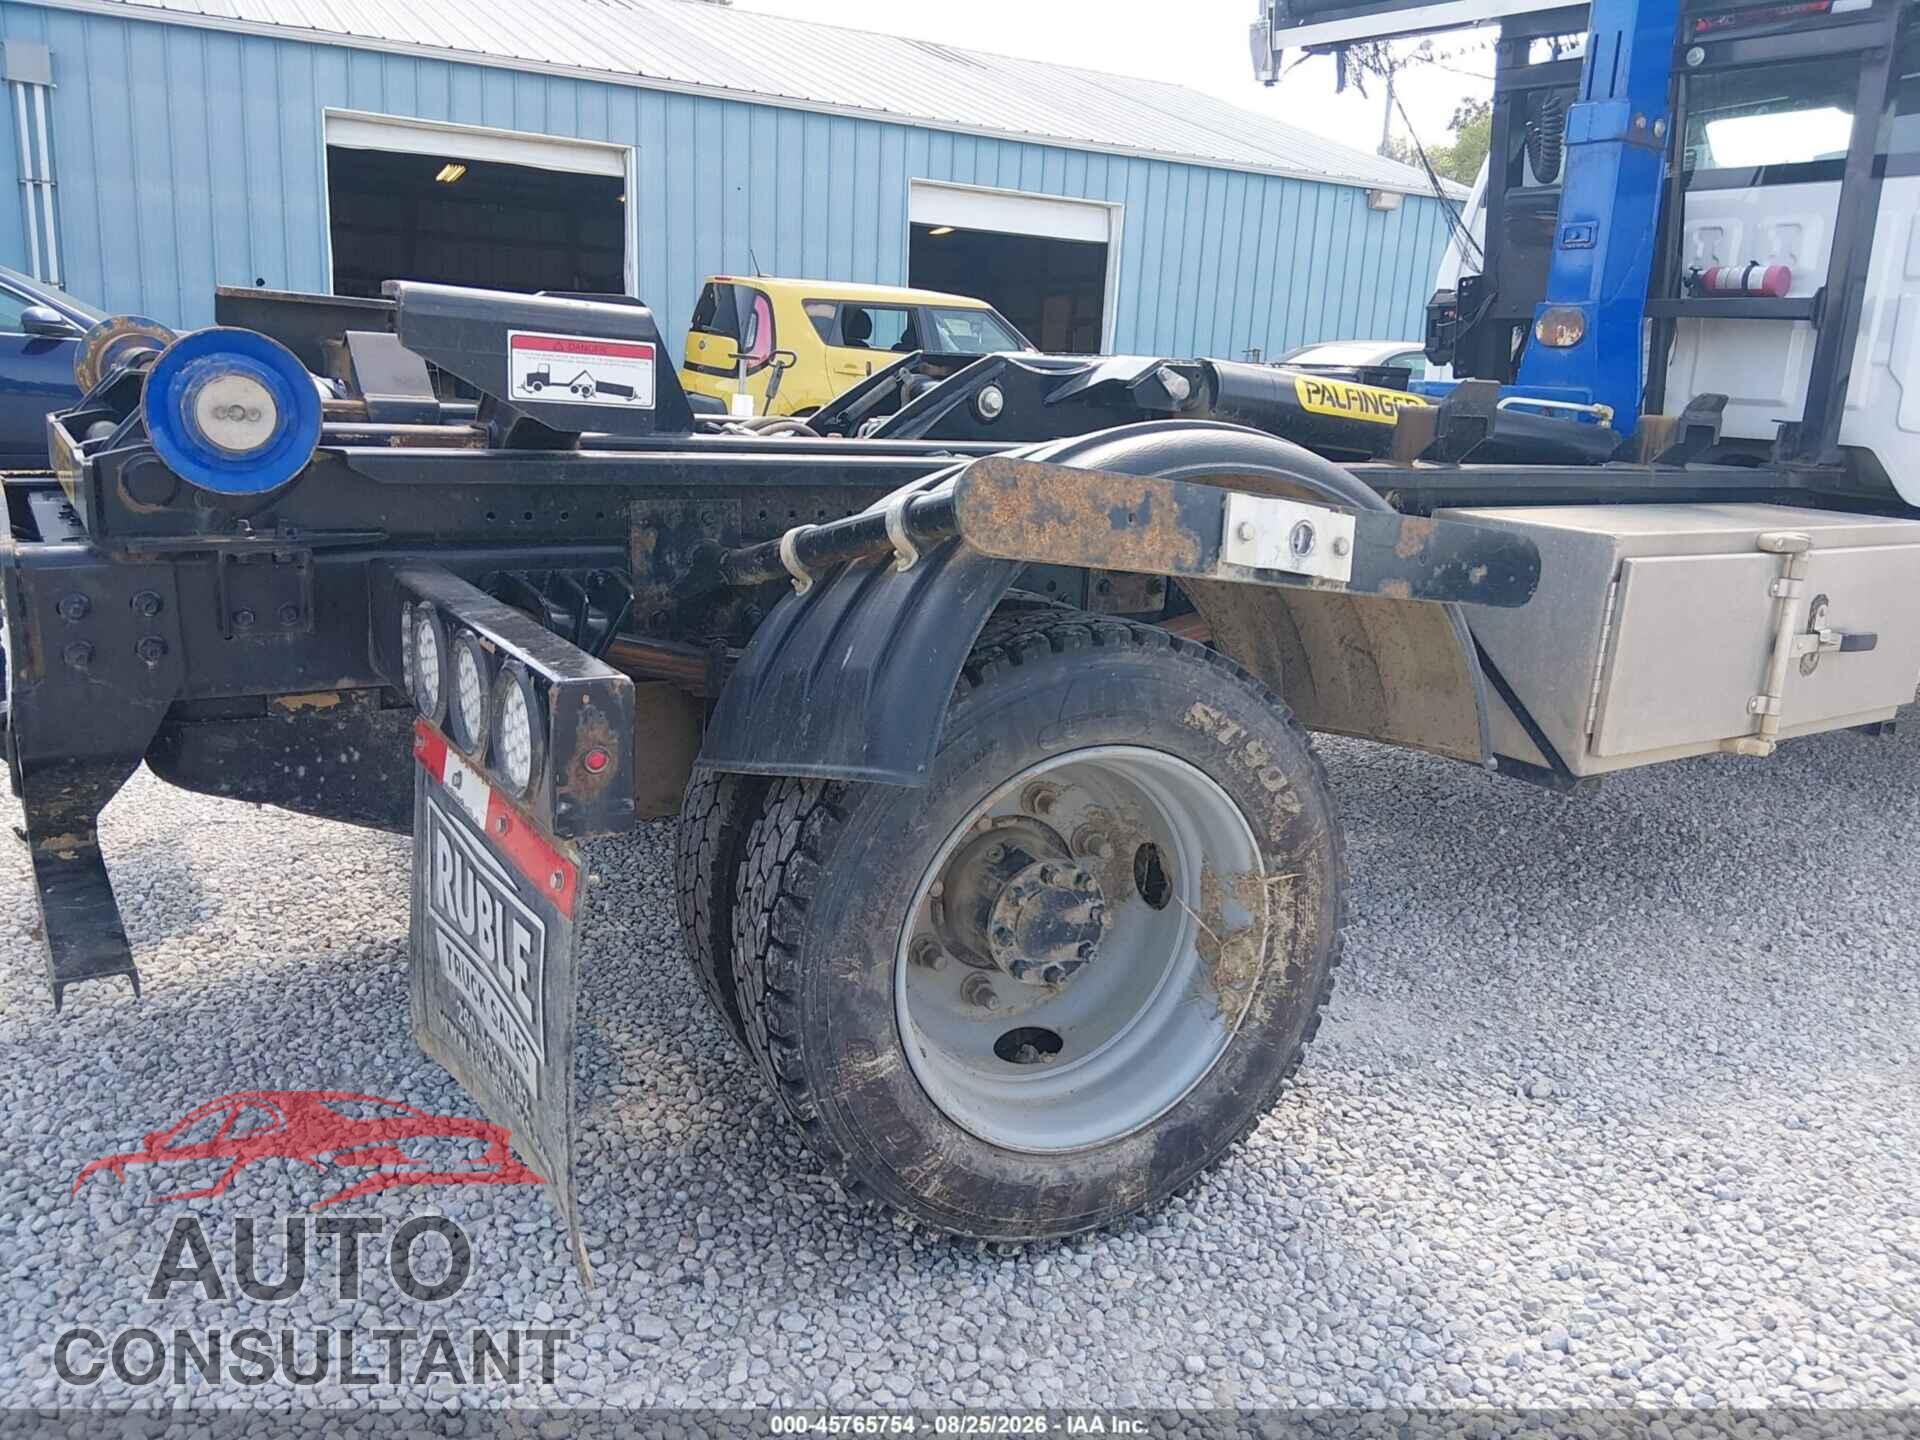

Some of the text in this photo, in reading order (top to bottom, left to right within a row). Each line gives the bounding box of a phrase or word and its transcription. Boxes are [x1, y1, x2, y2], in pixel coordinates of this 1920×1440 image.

[1305, 380, 1419, 416] PALFING
[436, 826, 534, 1024] RUBLE
[445, 942, 529, 1074] TRUCK SALES
